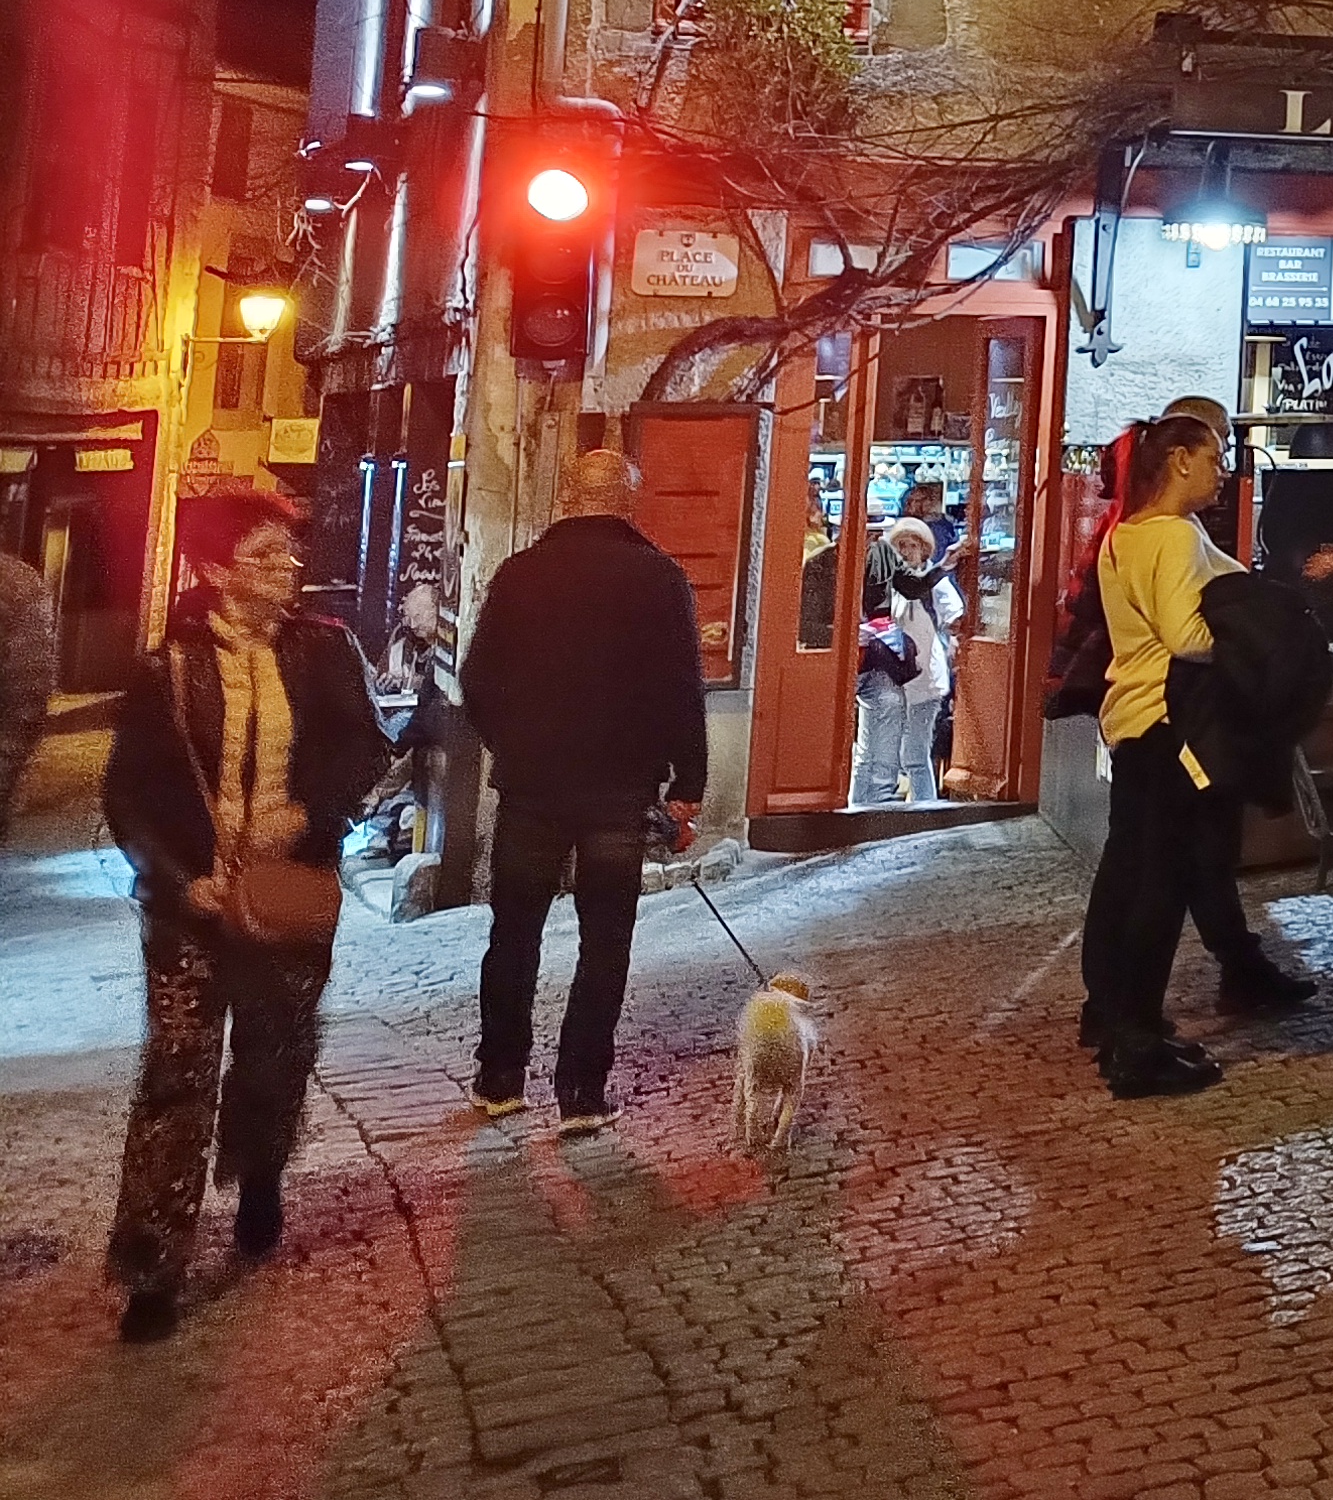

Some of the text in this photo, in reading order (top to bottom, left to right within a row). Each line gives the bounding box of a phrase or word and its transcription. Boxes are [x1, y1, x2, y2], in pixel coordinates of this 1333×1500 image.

[660, 250, 714, 264] PLACE
[1256, 246, 1326, 258] RESTAURANT
[677, 264, 694, 273] DU
[1278, 259, 1303, 270] BAR
[1261, 271, 1319, 283] BRASSERIE
[1249, 296, 1264, 308] 04
